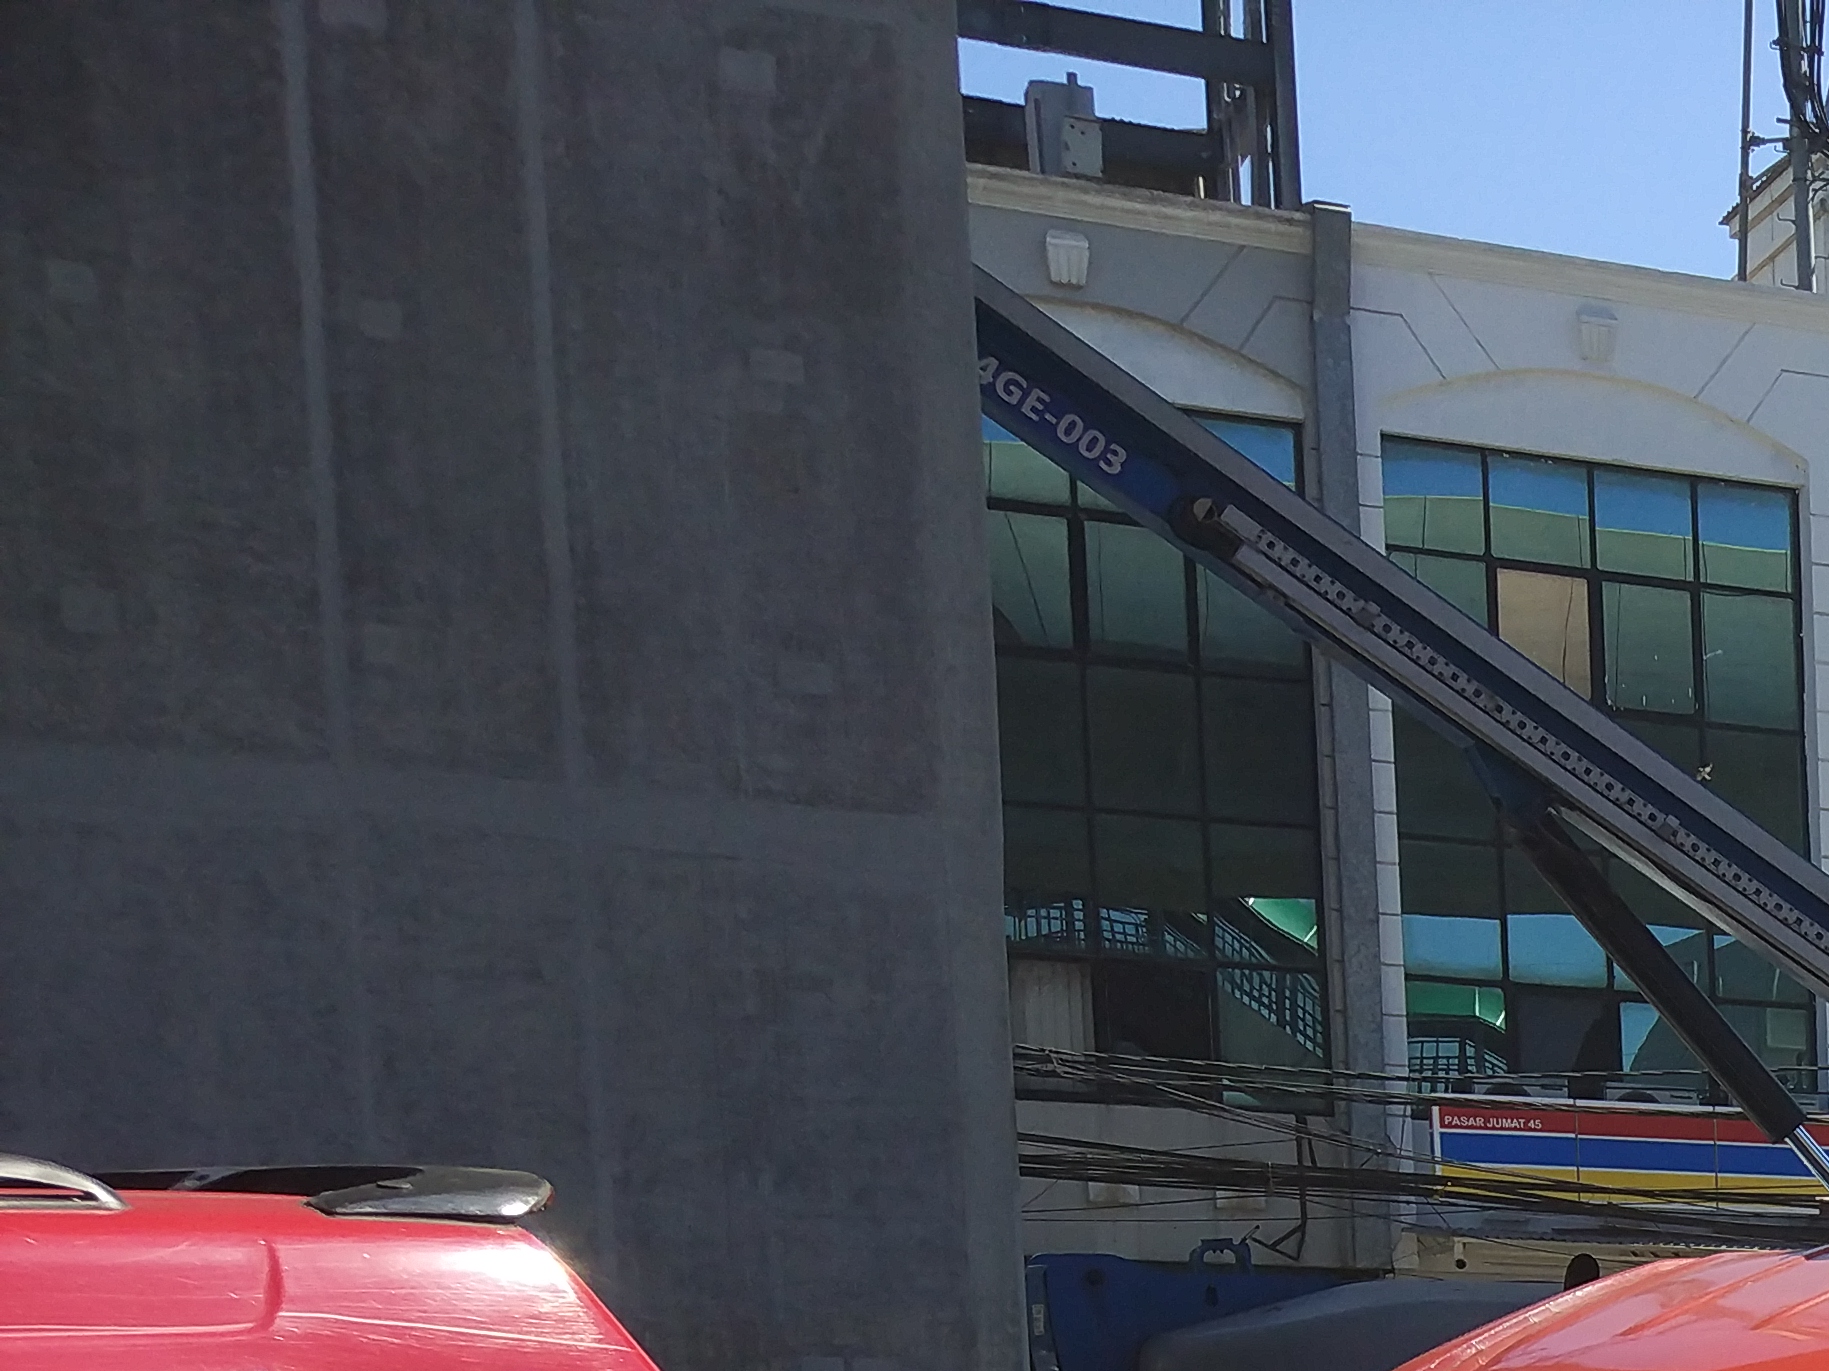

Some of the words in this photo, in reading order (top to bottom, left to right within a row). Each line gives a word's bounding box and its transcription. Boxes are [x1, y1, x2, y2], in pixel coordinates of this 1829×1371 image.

[1444, 1115, 1485, 1128] PASAR
[1486, 1116, 1526, 1129] JUMAT
[1527, 1117, 1542, 1130] 45
